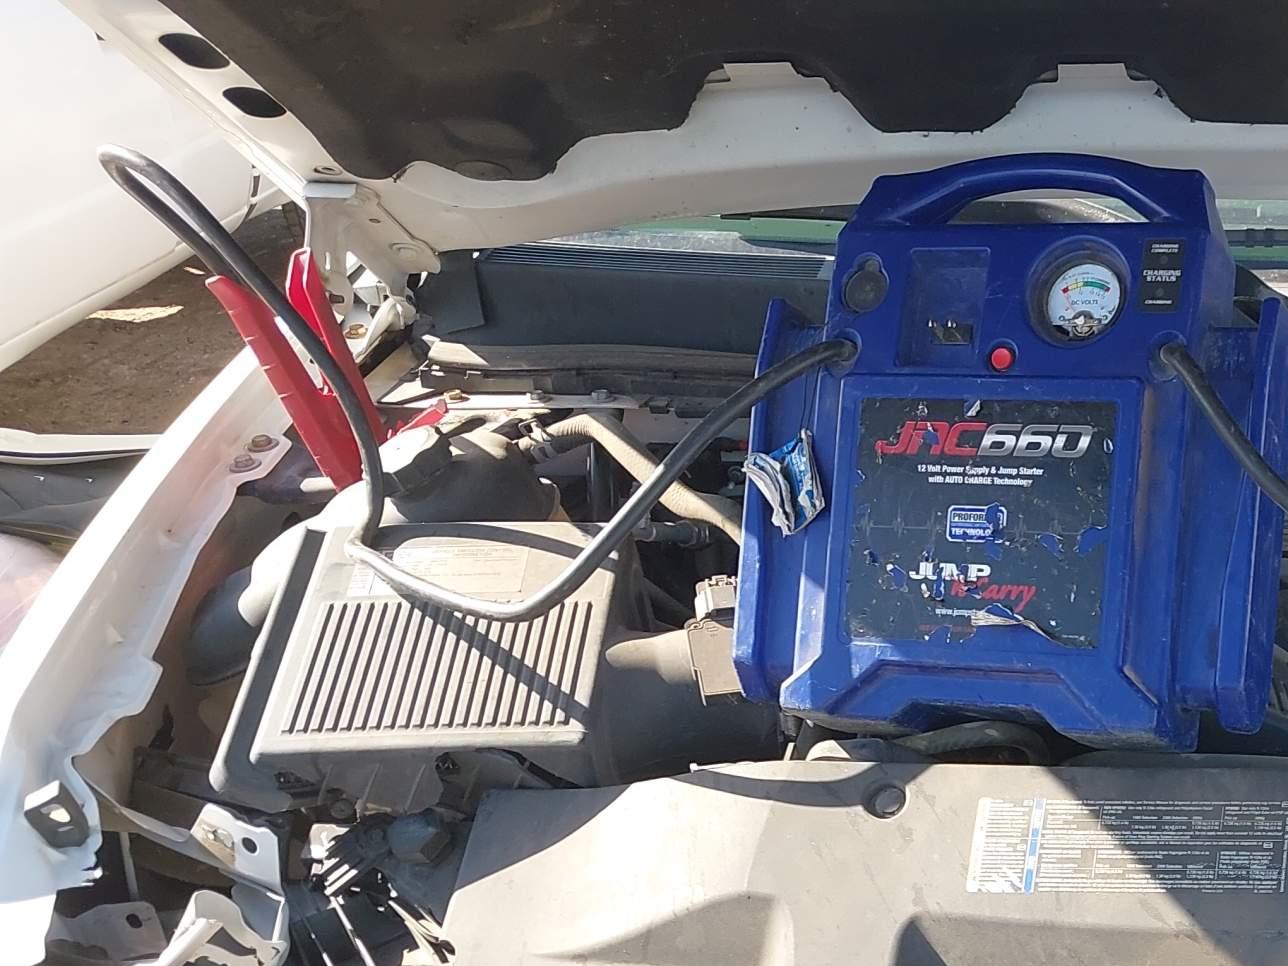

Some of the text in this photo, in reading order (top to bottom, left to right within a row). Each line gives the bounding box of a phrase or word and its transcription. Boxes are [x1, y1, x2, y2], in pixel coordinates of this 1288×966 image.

[917, 464, 1044, 476] 12 Volt Power Supply & Jump Starter
[928, 475, 1033, 487] with AUTO CHARGE Technology
